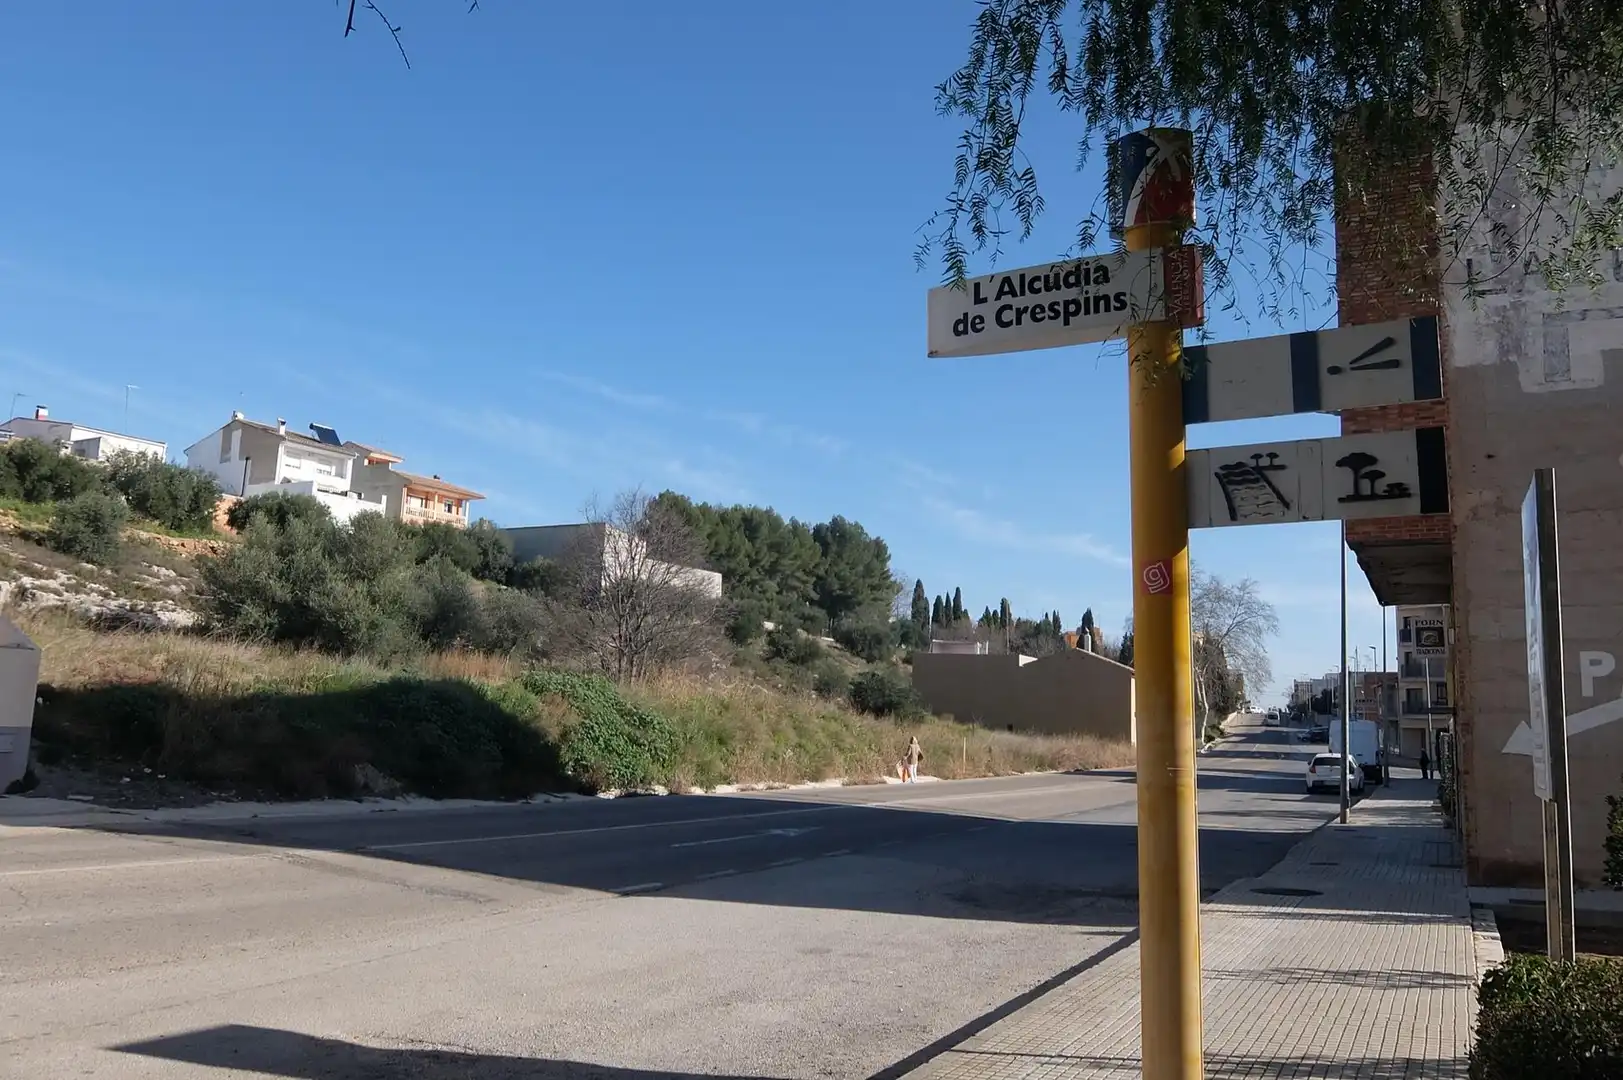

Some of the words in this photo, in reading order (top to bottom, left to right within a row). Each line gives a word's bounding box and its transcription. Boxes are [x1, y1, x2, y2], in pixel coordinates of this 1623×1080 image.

[952, 312, 986, 337] de
[994, 290, 1128, 327] Crespins
[1415, 619, 1444, 627] FORN
[1579, 650, 1616, 697] P
